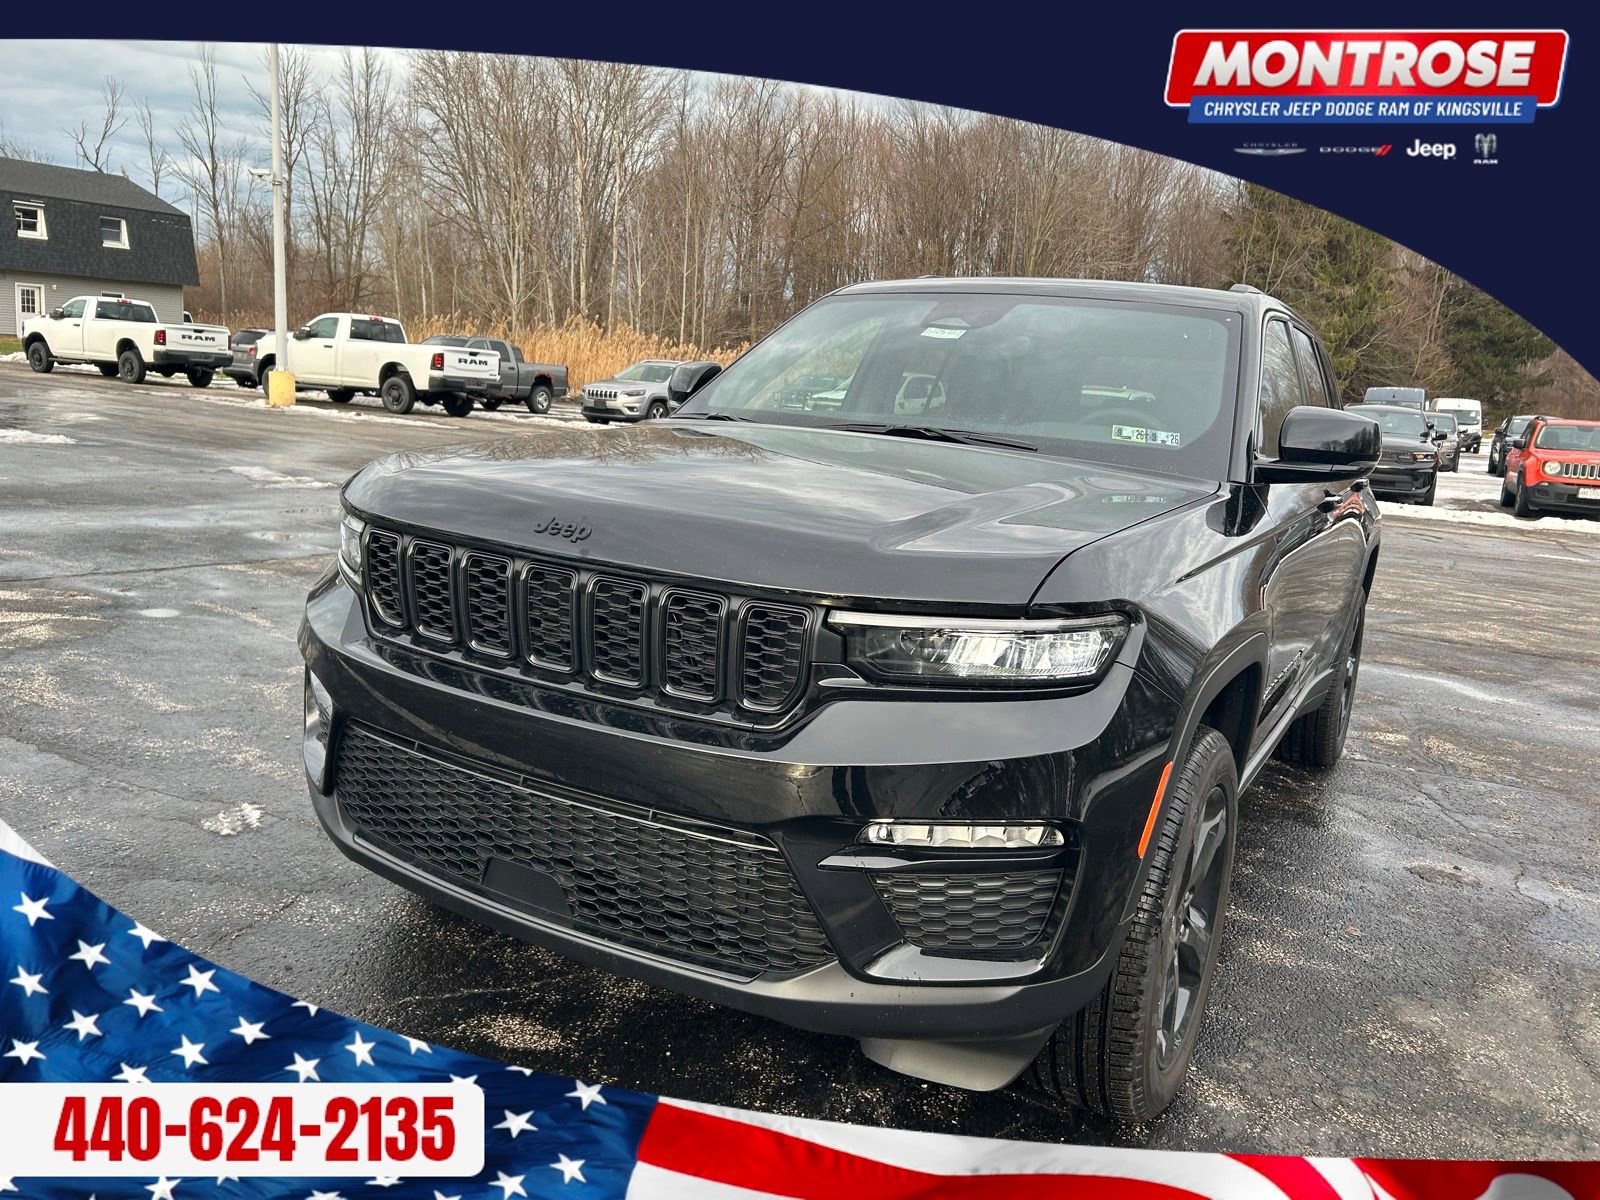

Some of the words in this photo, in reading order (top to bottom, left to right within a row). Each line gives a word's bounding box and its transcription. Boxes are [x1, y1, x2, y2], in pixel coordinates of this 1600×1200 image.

[181, 334, 216, 342] RAM
[458, 357, 488, 366] RAM
[1170, 433, 1179, 445] 26
[533, 516, 593, 543] Jeep
